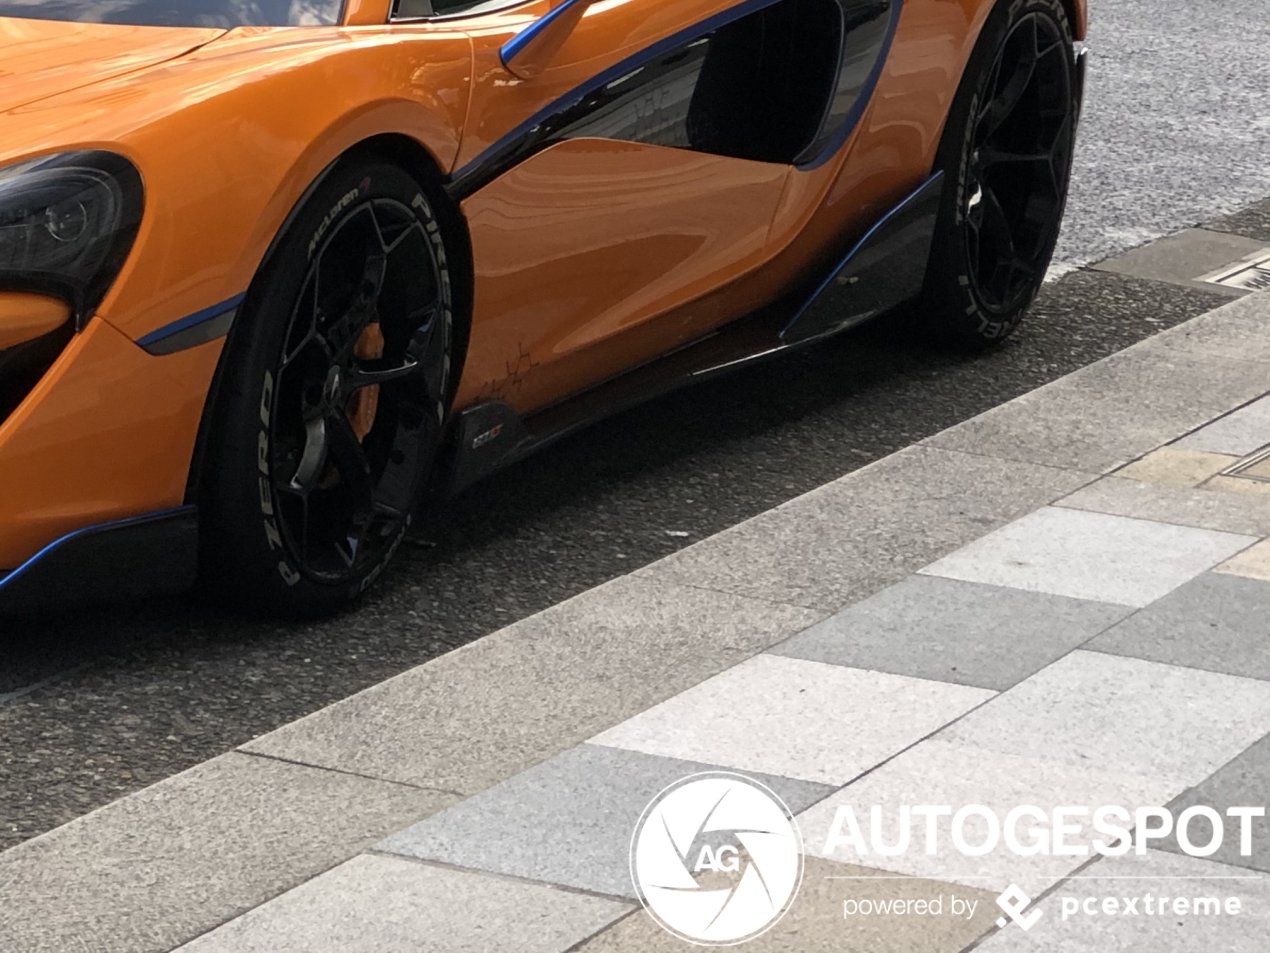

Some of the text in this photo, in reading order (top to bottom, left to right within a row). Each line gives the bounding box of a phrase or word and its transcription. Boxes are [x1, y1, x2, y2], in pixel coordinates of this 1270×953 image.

[307, 188, 360, 262] McLaren
[411, 192, 453, 428] PIRELLI
[258, 369, 301, 587] P ZERO
